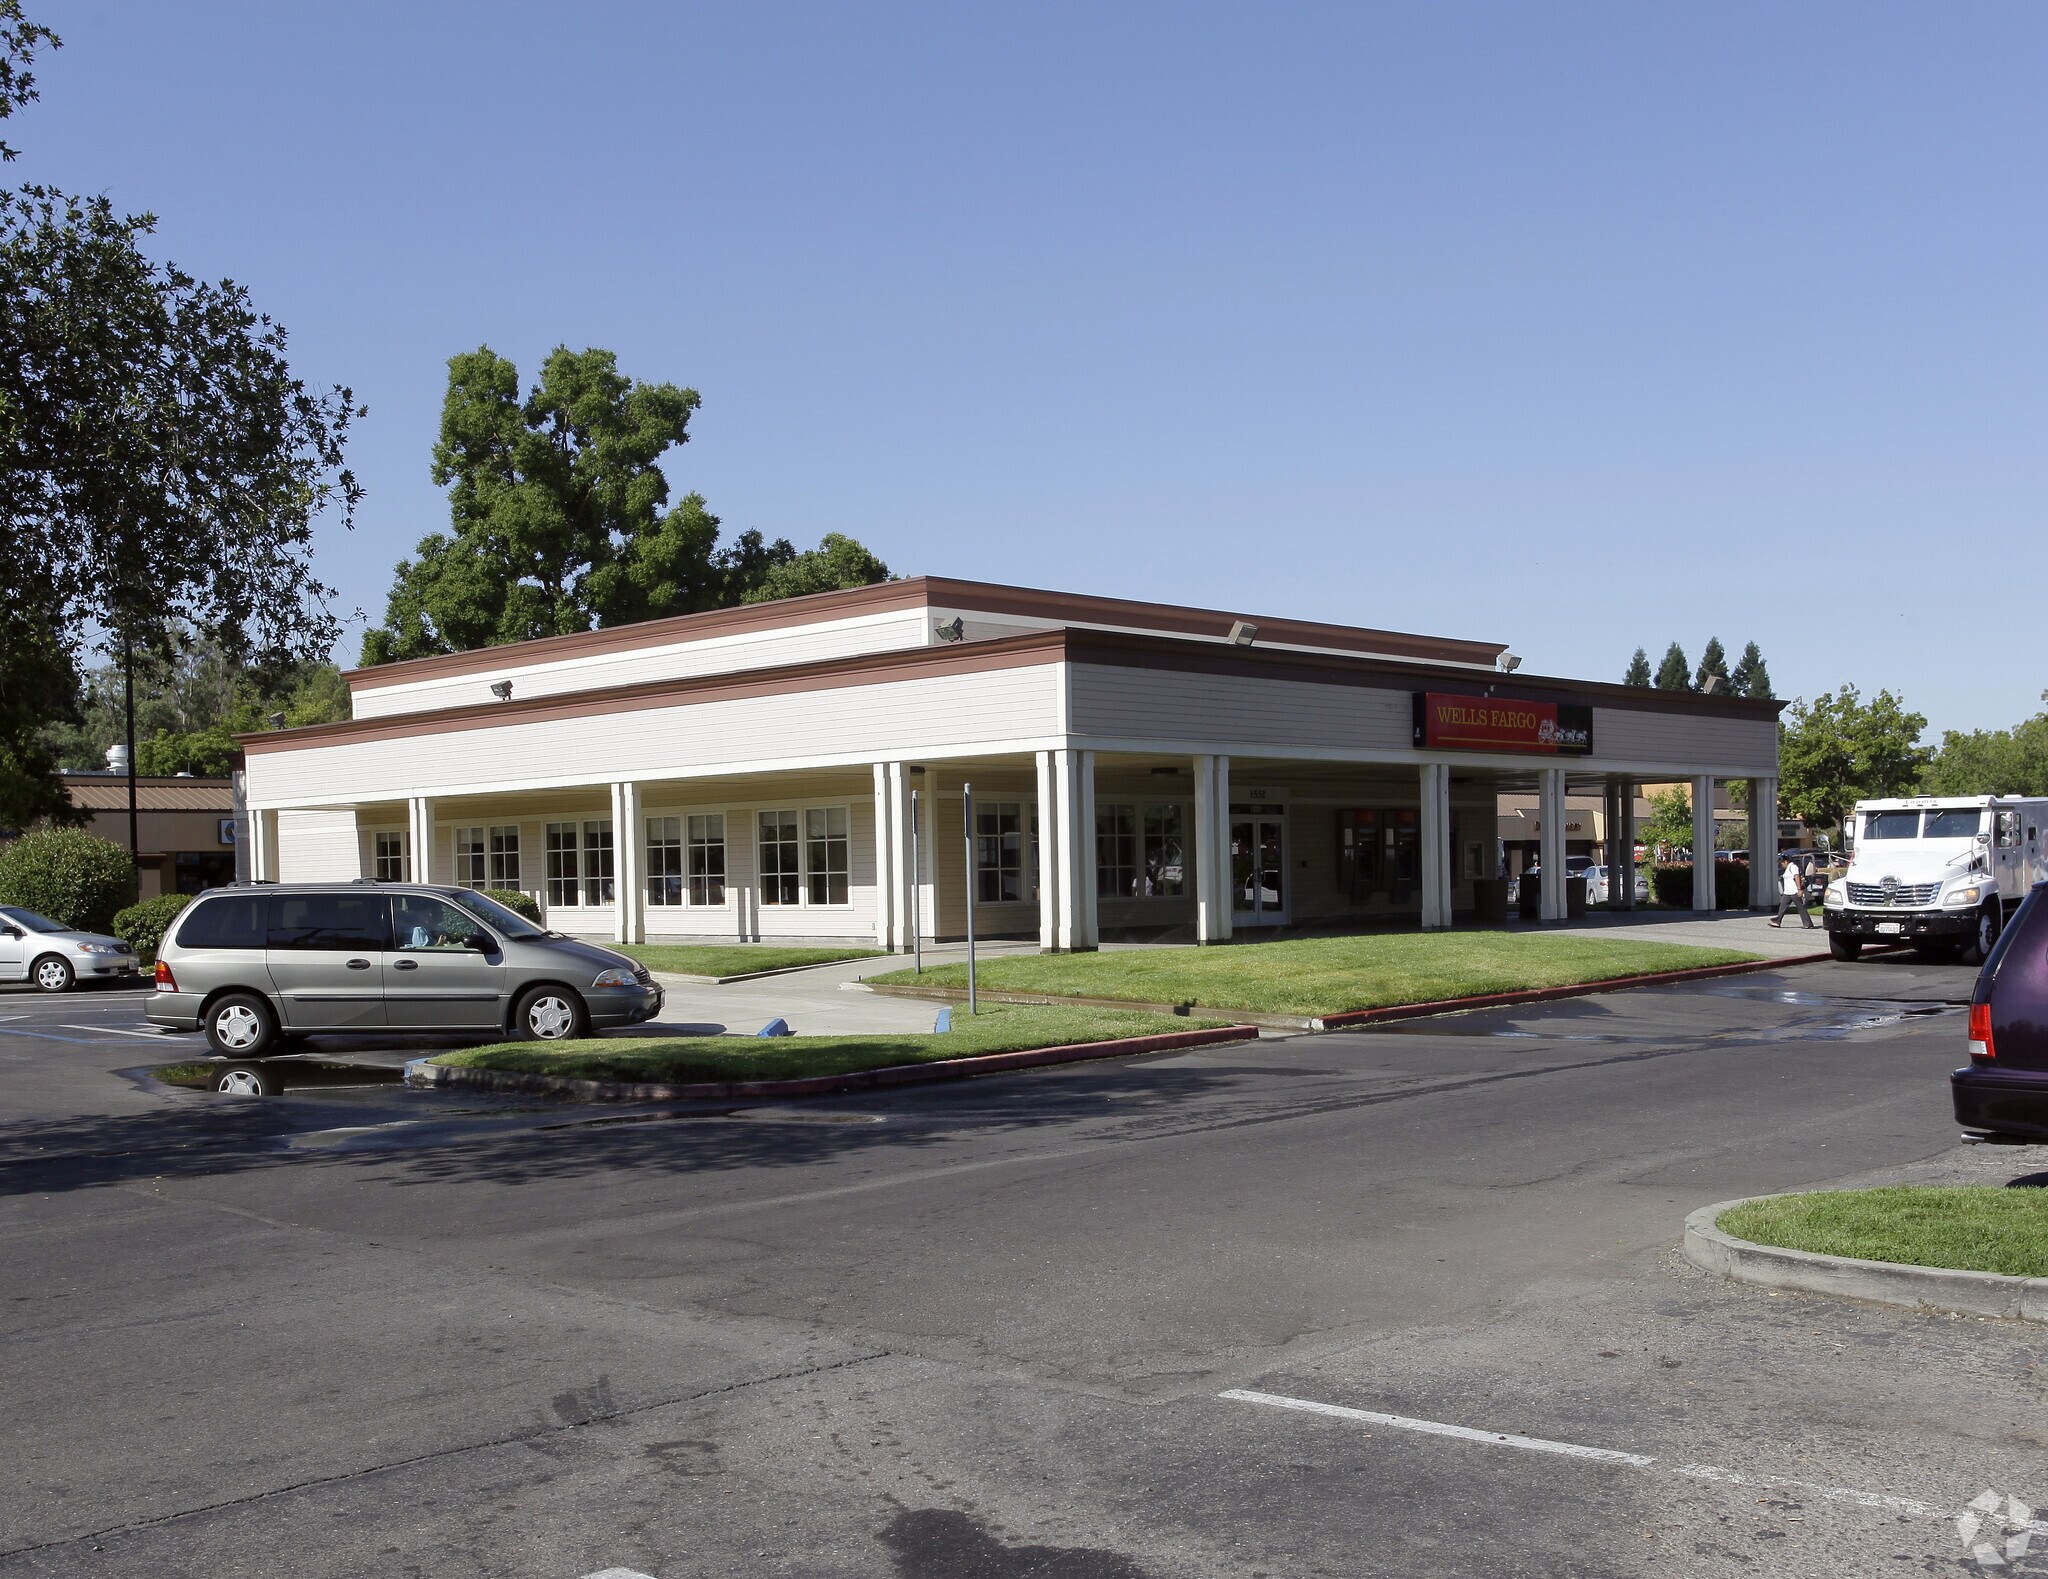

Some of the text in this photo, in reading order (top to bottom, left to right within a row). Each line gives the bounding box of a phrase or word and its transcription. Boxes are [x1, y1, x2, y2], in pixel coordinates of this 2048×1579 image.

[1437, 706, 1536, 729] WELLS FARGO
[1250, 789, 1266, 799] 1532
